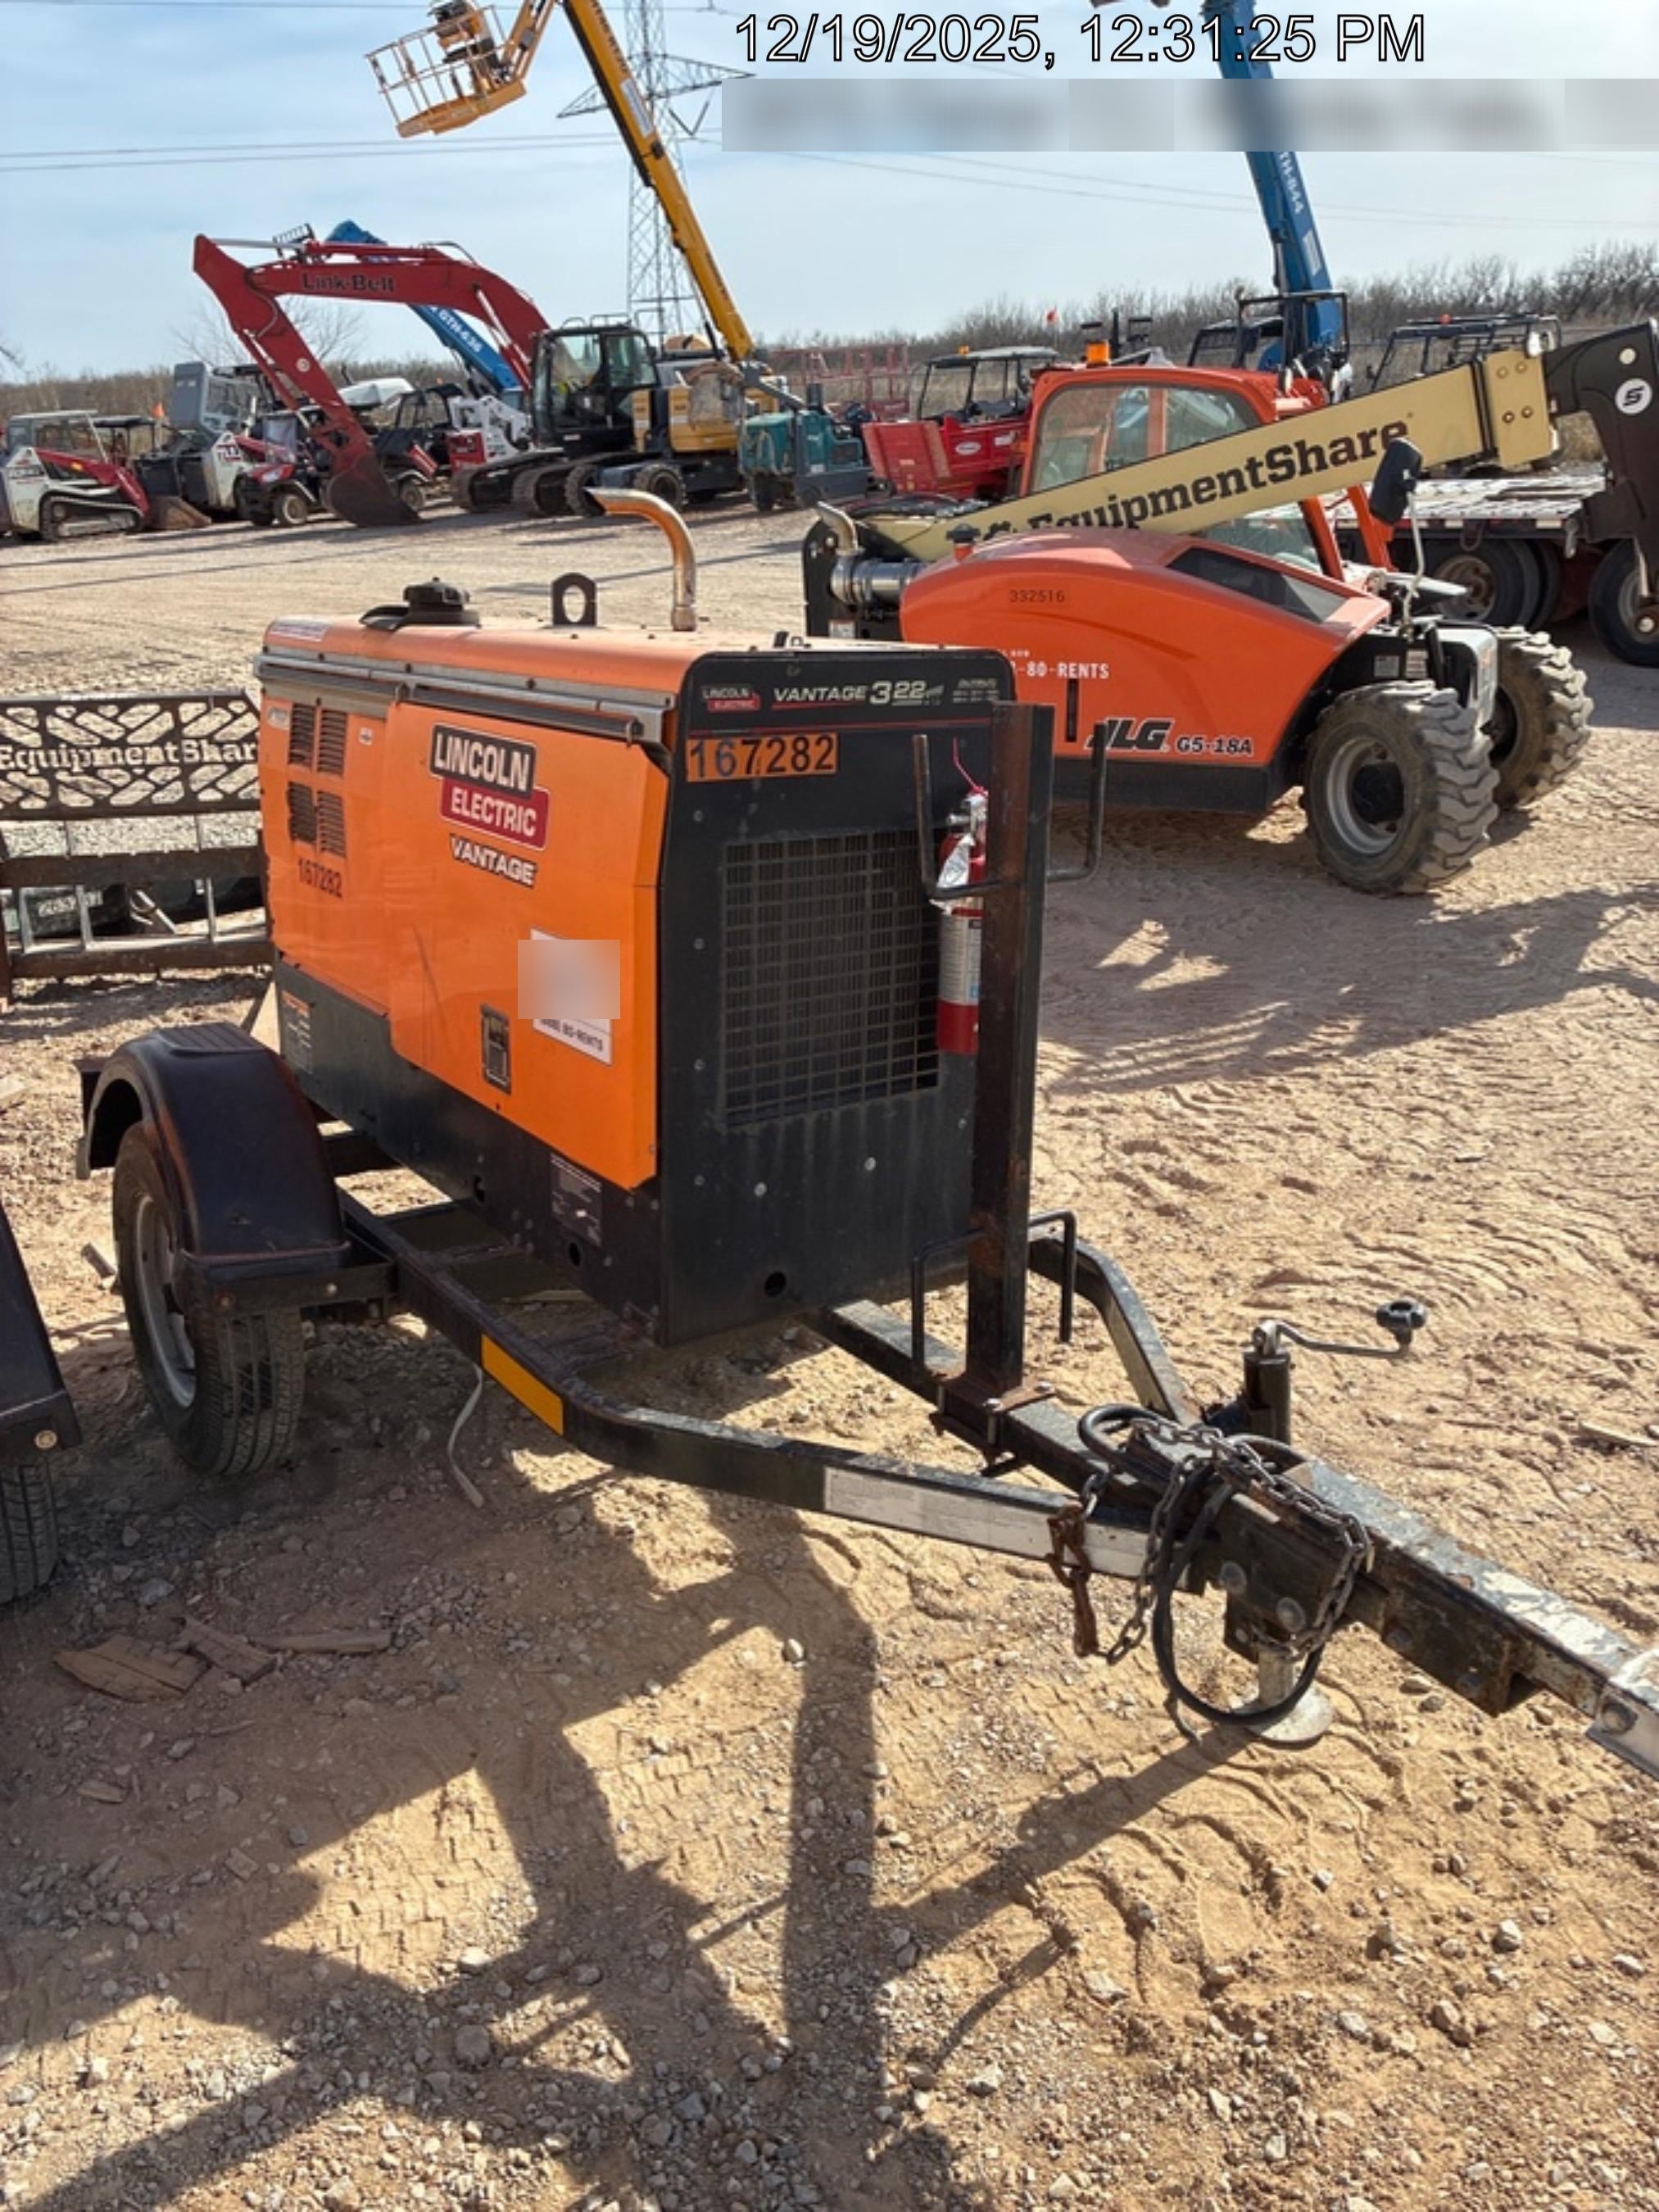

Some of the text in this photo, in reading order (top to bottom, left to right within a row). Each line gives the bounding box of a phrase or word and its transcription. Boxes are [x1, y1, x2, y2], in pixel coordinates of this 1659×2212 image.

[302, 273, 395, 292] Link-Belt
[1009, 589, 1066, 603] 332516
[702, 687, 750, 699] LINCOLN
[773, 685, 868, 702] VANTAGE
[0, 738, 256, 774] EquipmentShar
[689, 734, 836, 778] 167282
[1176, 736, 1253, 755] G5-18A
[434, 733, 530, 792] LINCOLN
[451, 786, 537, 837] ELECTRIC
[450, 834, 537, 888] VANTAGE
